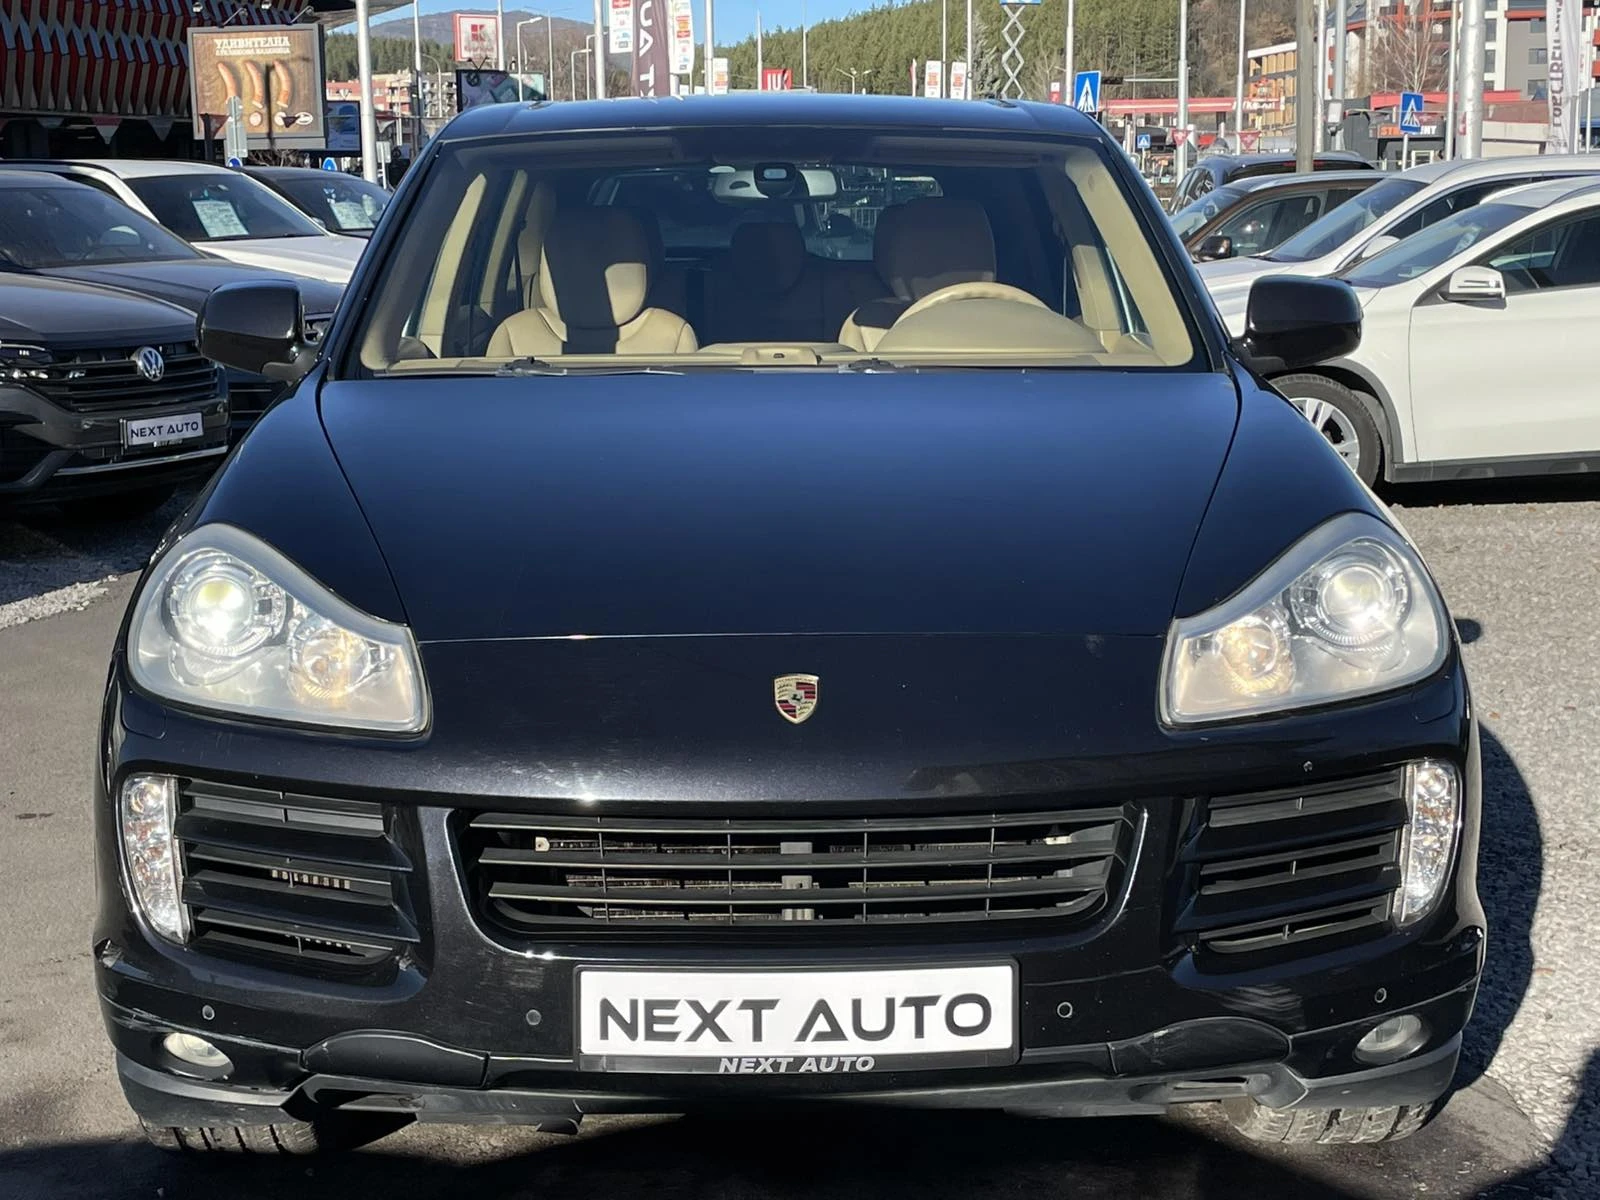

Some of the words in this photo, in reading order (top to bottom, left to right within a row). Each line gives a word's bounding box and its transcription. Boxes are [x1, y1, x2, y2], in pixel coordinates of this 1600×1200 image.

[130, 425, 163, 439] NEXT
[166, 421, 199, 435] AUTO
[599, 997, 781, 1043] NEXT
[794, 992, 993, 1043] AUTO
[719, 1057, 795, 1074] NEXT
[799, 1055, 875, 1073] AUTO
